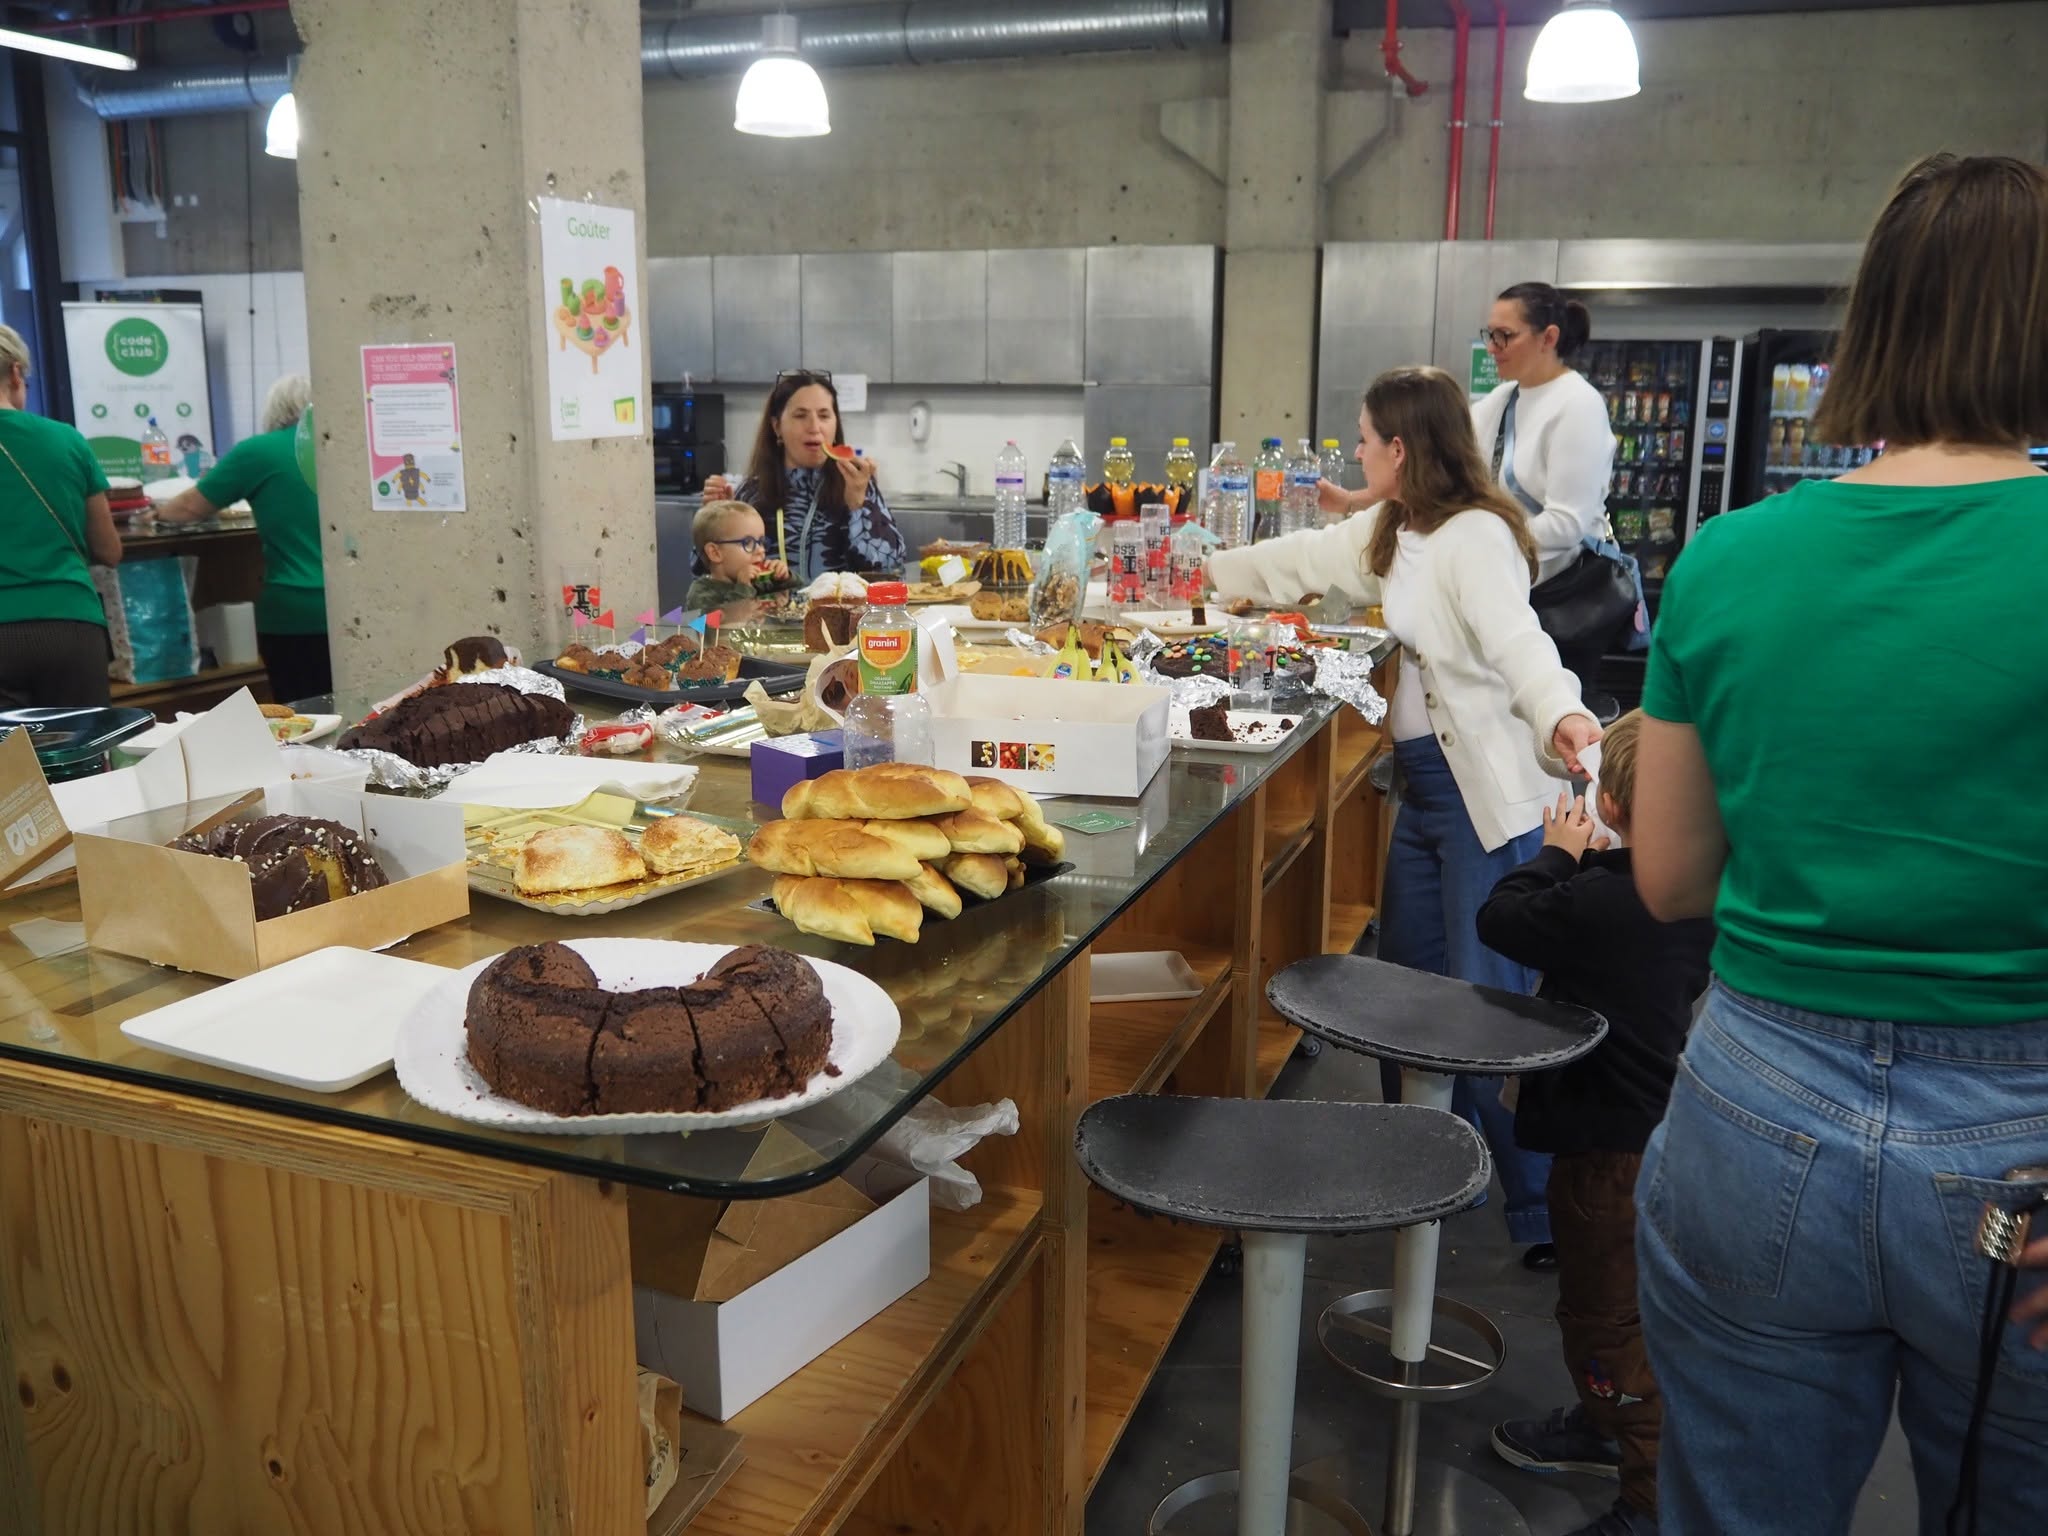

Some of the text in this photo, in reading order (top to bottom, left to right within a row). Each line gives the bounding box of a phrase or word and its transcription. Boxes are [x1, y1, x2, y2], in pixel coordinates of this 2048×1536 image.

[567, 216, 611, 240] Goûter
[119, 335, 153, 346] code
[120, 347, 154, 357] club
[868, 638, 898, 649] granini
